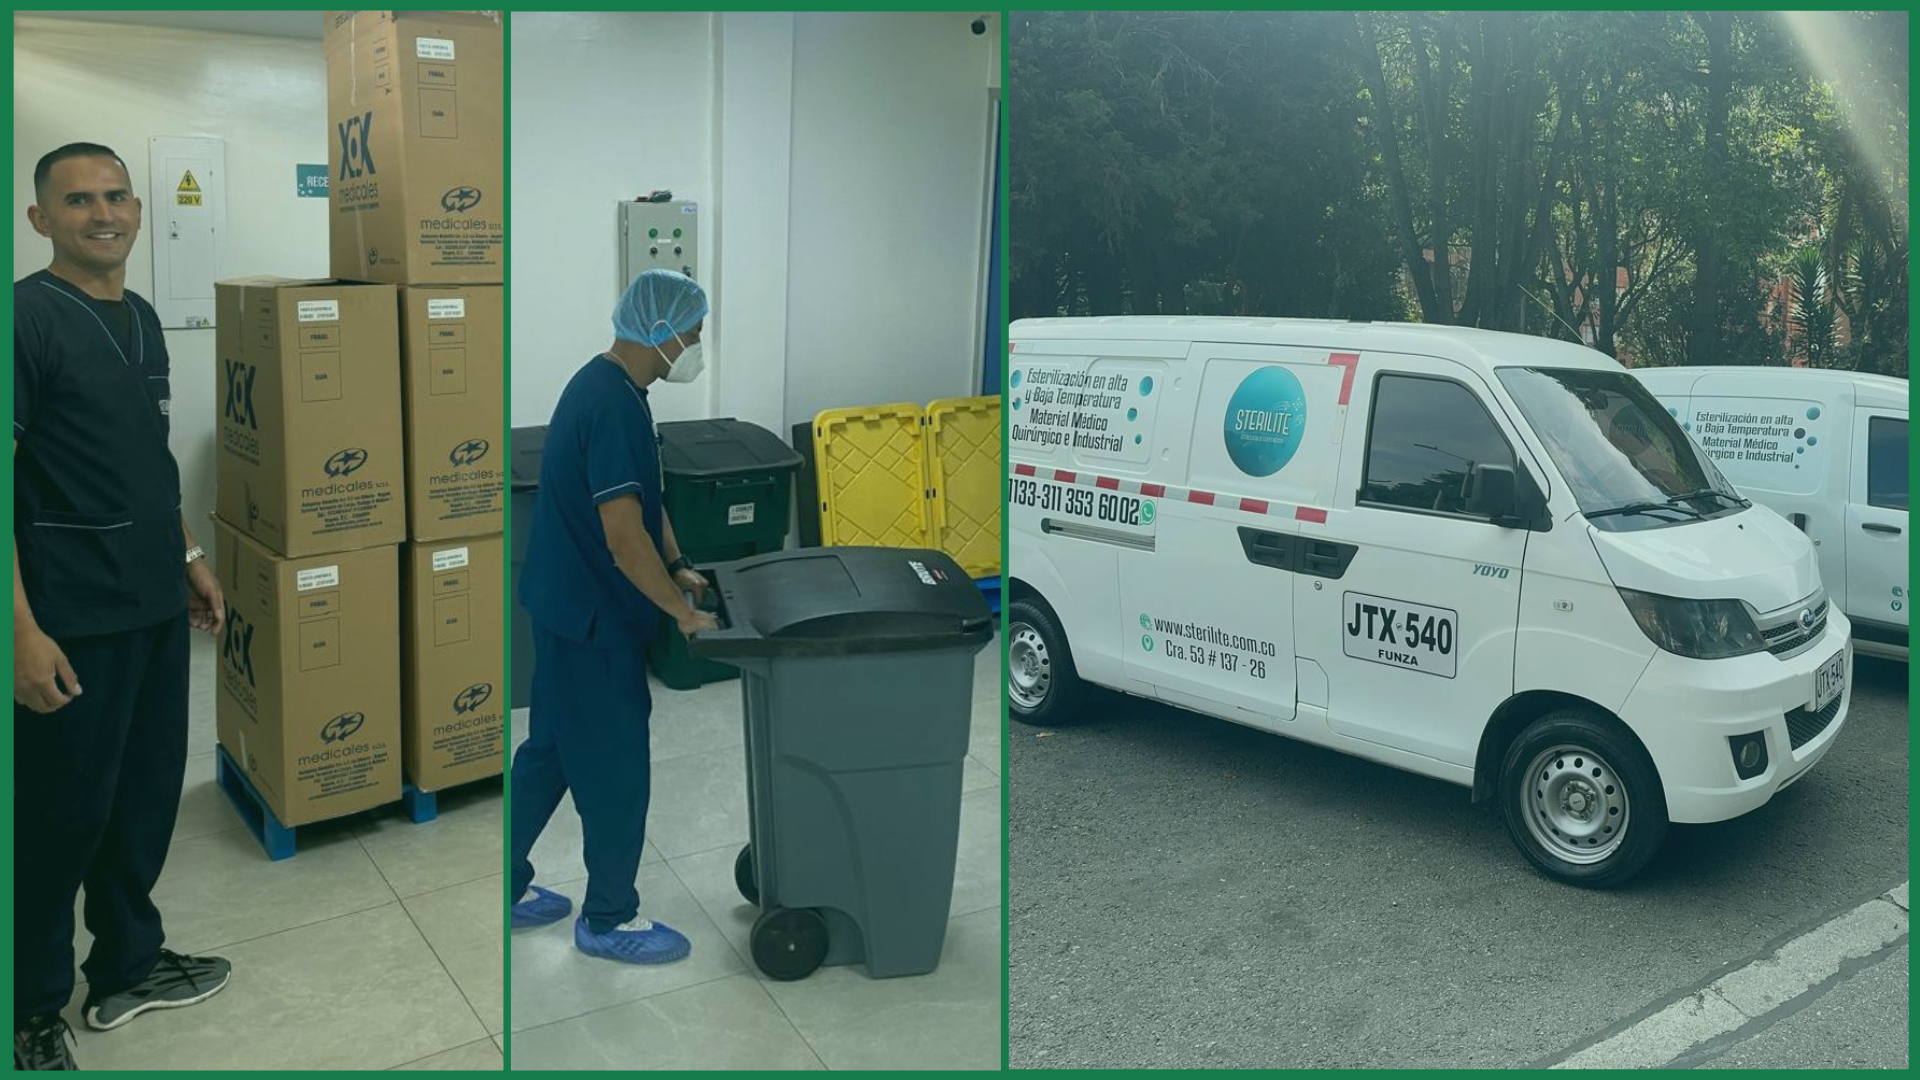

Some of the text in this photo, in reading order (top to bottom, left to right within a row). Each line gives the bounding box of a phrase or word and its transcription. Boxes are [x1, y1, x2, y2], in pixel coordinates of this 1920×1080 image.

[306, 174, 330, 188] RECE
[179, 194, 201, 204] 220 V
[420, 217, 487, 230] medicales
[1026, 366, 1129, 392] Esterilización en alta
[1024, 387, 1123, 410] y Baja Temperatura
[1029, 408, 1109, 431] Material Médico
[1235, 408, 1292, 436] STERILITE
[1696, 410, 1795, 426] Esterilización en alta
[1011, 424, 1125, 452] Quirúrgico e Industrial
[1696, 422, 1791, 438] y Baja Temperatura
[1702, 436, 1780, 450] Material Médico
[1736, 450, 1744, 460] e
[1745, 449, 1795, 464] Industrial
[429, 470, 494, 485] medicales
[301, 481, 374, 498] medicales
[1065, 488, 1095, 517] 353
[1098, 492, 1141, 526] 6002
[1473, 564, 1509, 579] YOYO
[1154, 618, 1276, 658] www.sterilite.com.co
[1347, 602, 1453, 655] JTX 540
[1165, 639, 1188, 661] Cra.
[1189, 645, 1206, 665] 53
[1208, 650, 1217, 667] #
[1219, 652, 1239, 672] 137
[1249, 659, 1267, 679] 26
[1378, 649, 1419, 666] FUNZA
[1818, 658, 1845, 698] JTX 540
[433, 714, 496, 736] medicales
[298, 744, 370, 766] medicales
